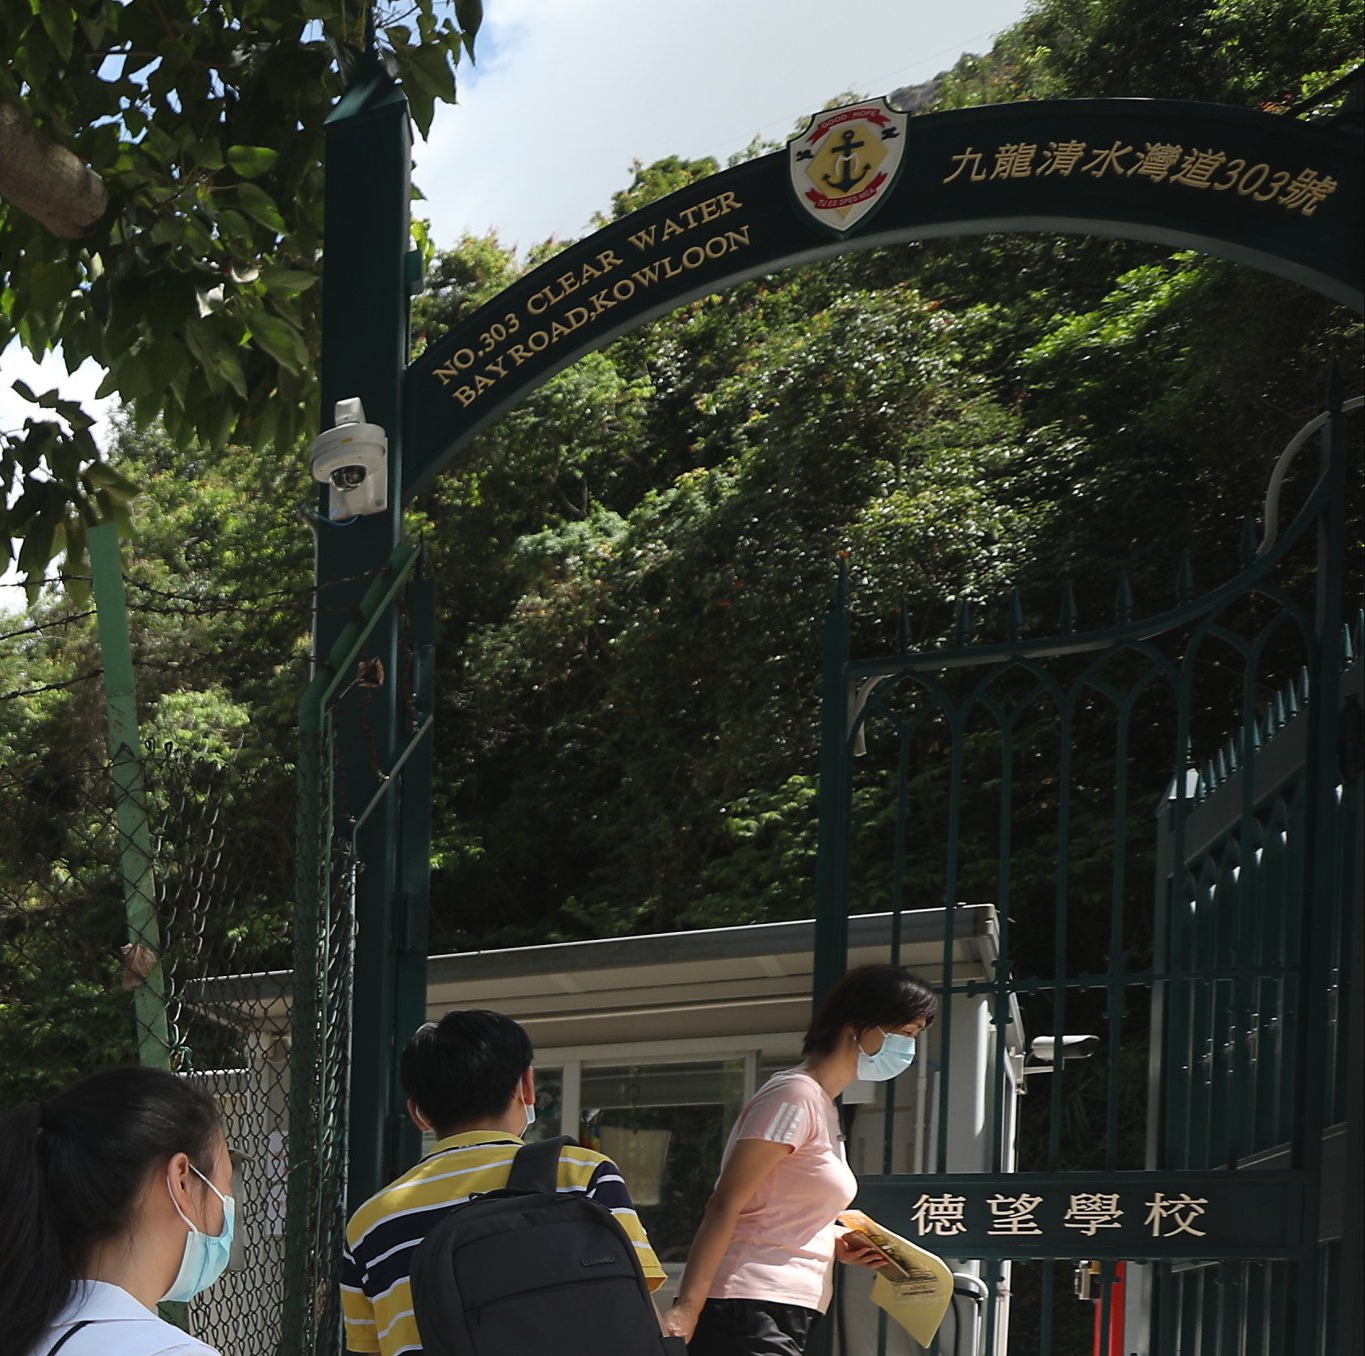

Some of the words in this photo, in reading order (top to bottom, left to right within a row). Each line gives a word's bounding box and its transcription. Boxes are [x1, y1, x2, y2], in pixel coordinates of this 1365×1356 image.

[821, 114, 847, 129] GOOD
[852, 110, 876, 118] HOPE
[943, 138, 1338, 218] 九龍清水灣道303號
[432, 314, 521, 387] NO.303
[526, 249, 623, 316] CLEAR
[628, 190, 744, 252] WATER
[452, 358, 511, 408] BAY
[910, 1191, 1210, 1238] 德望學校
